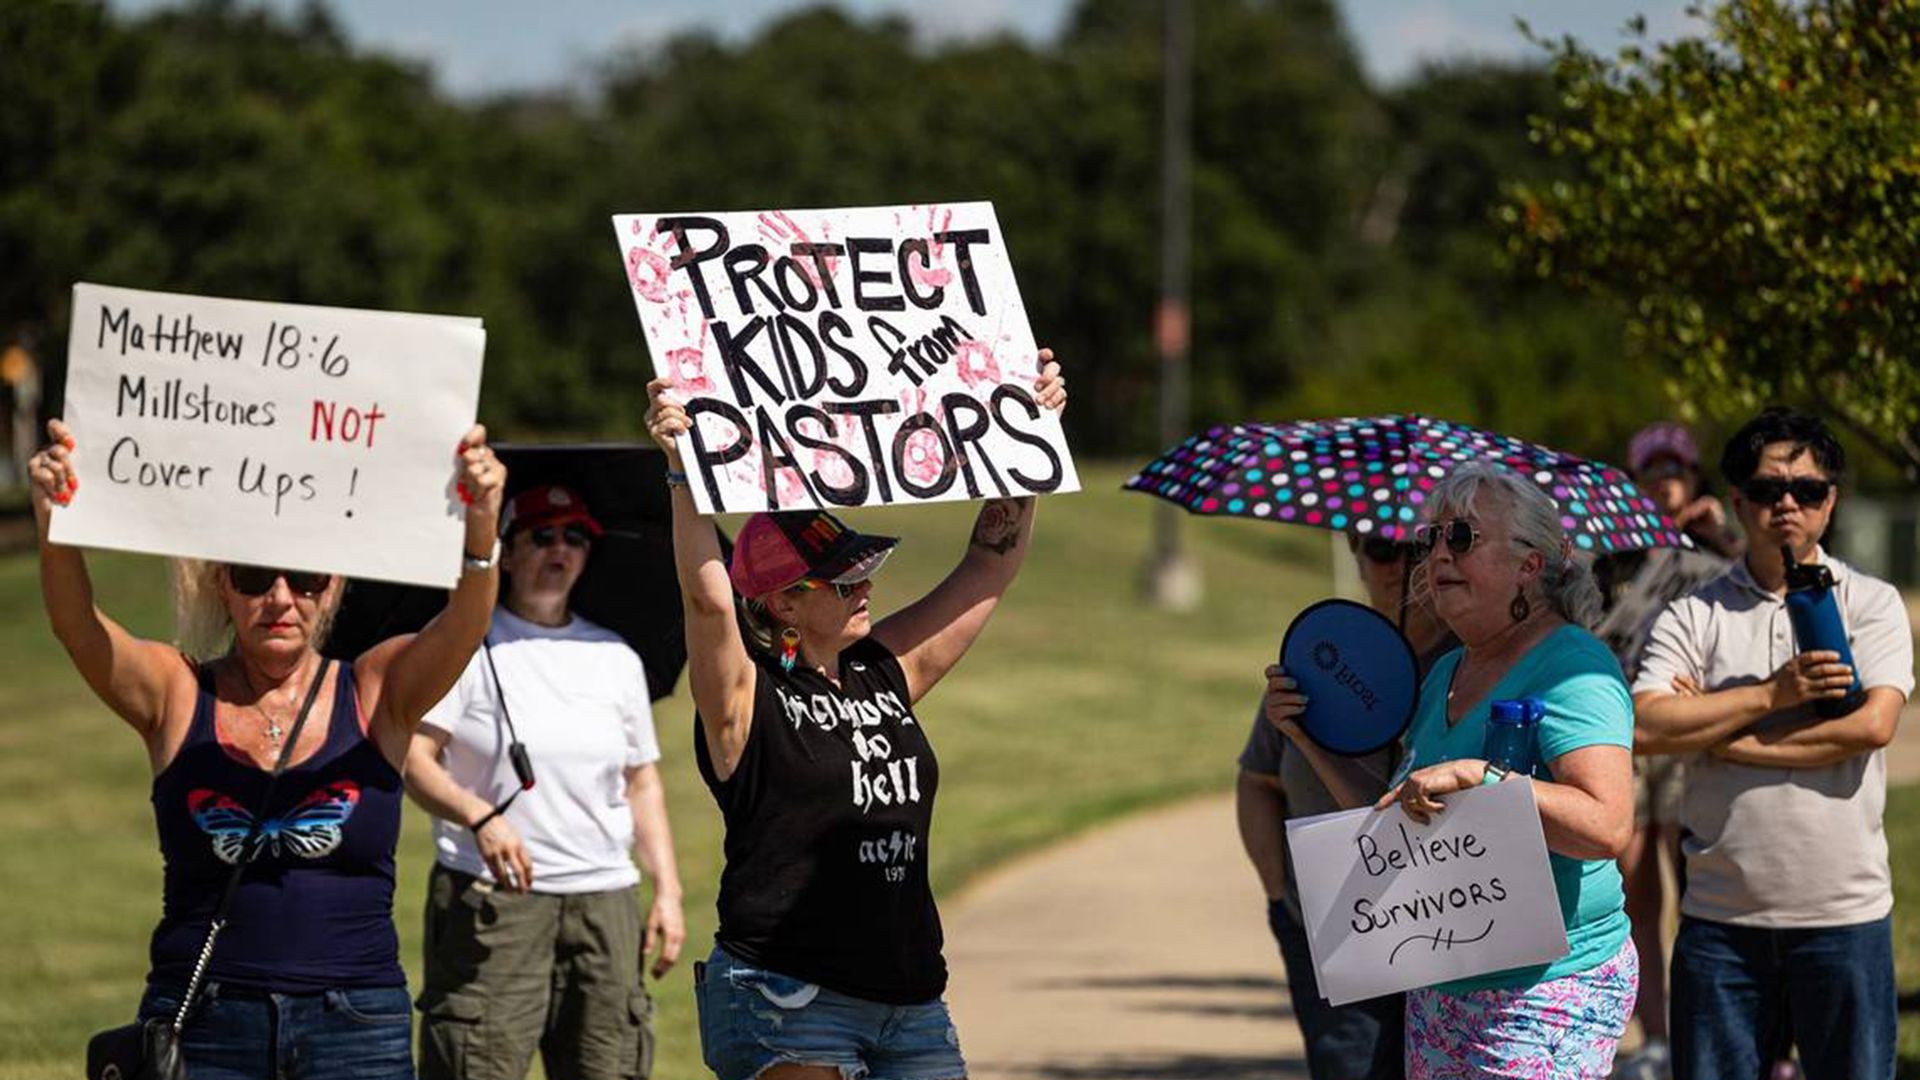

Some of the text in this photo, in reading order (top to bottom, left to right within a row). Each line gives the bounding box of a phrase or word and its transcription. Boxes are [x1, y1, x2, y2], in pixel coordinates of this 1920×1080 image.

[657, 216, 990, 320] PROTECT
[98, 306, 350, 377] Matthew 18:6
[711, 310, 974, 408] KIDS from
[117, 375, 275, 427] Millstones
[108, 436, 212, 491] Cover
[239, 458, 317, 517] Ups
[685, 383, 1064, 513] PASTORS
[852, 729, 892, 762] to
[851, 757, 921, 814] hell
[1357, 822, 1487, 877] Believe
